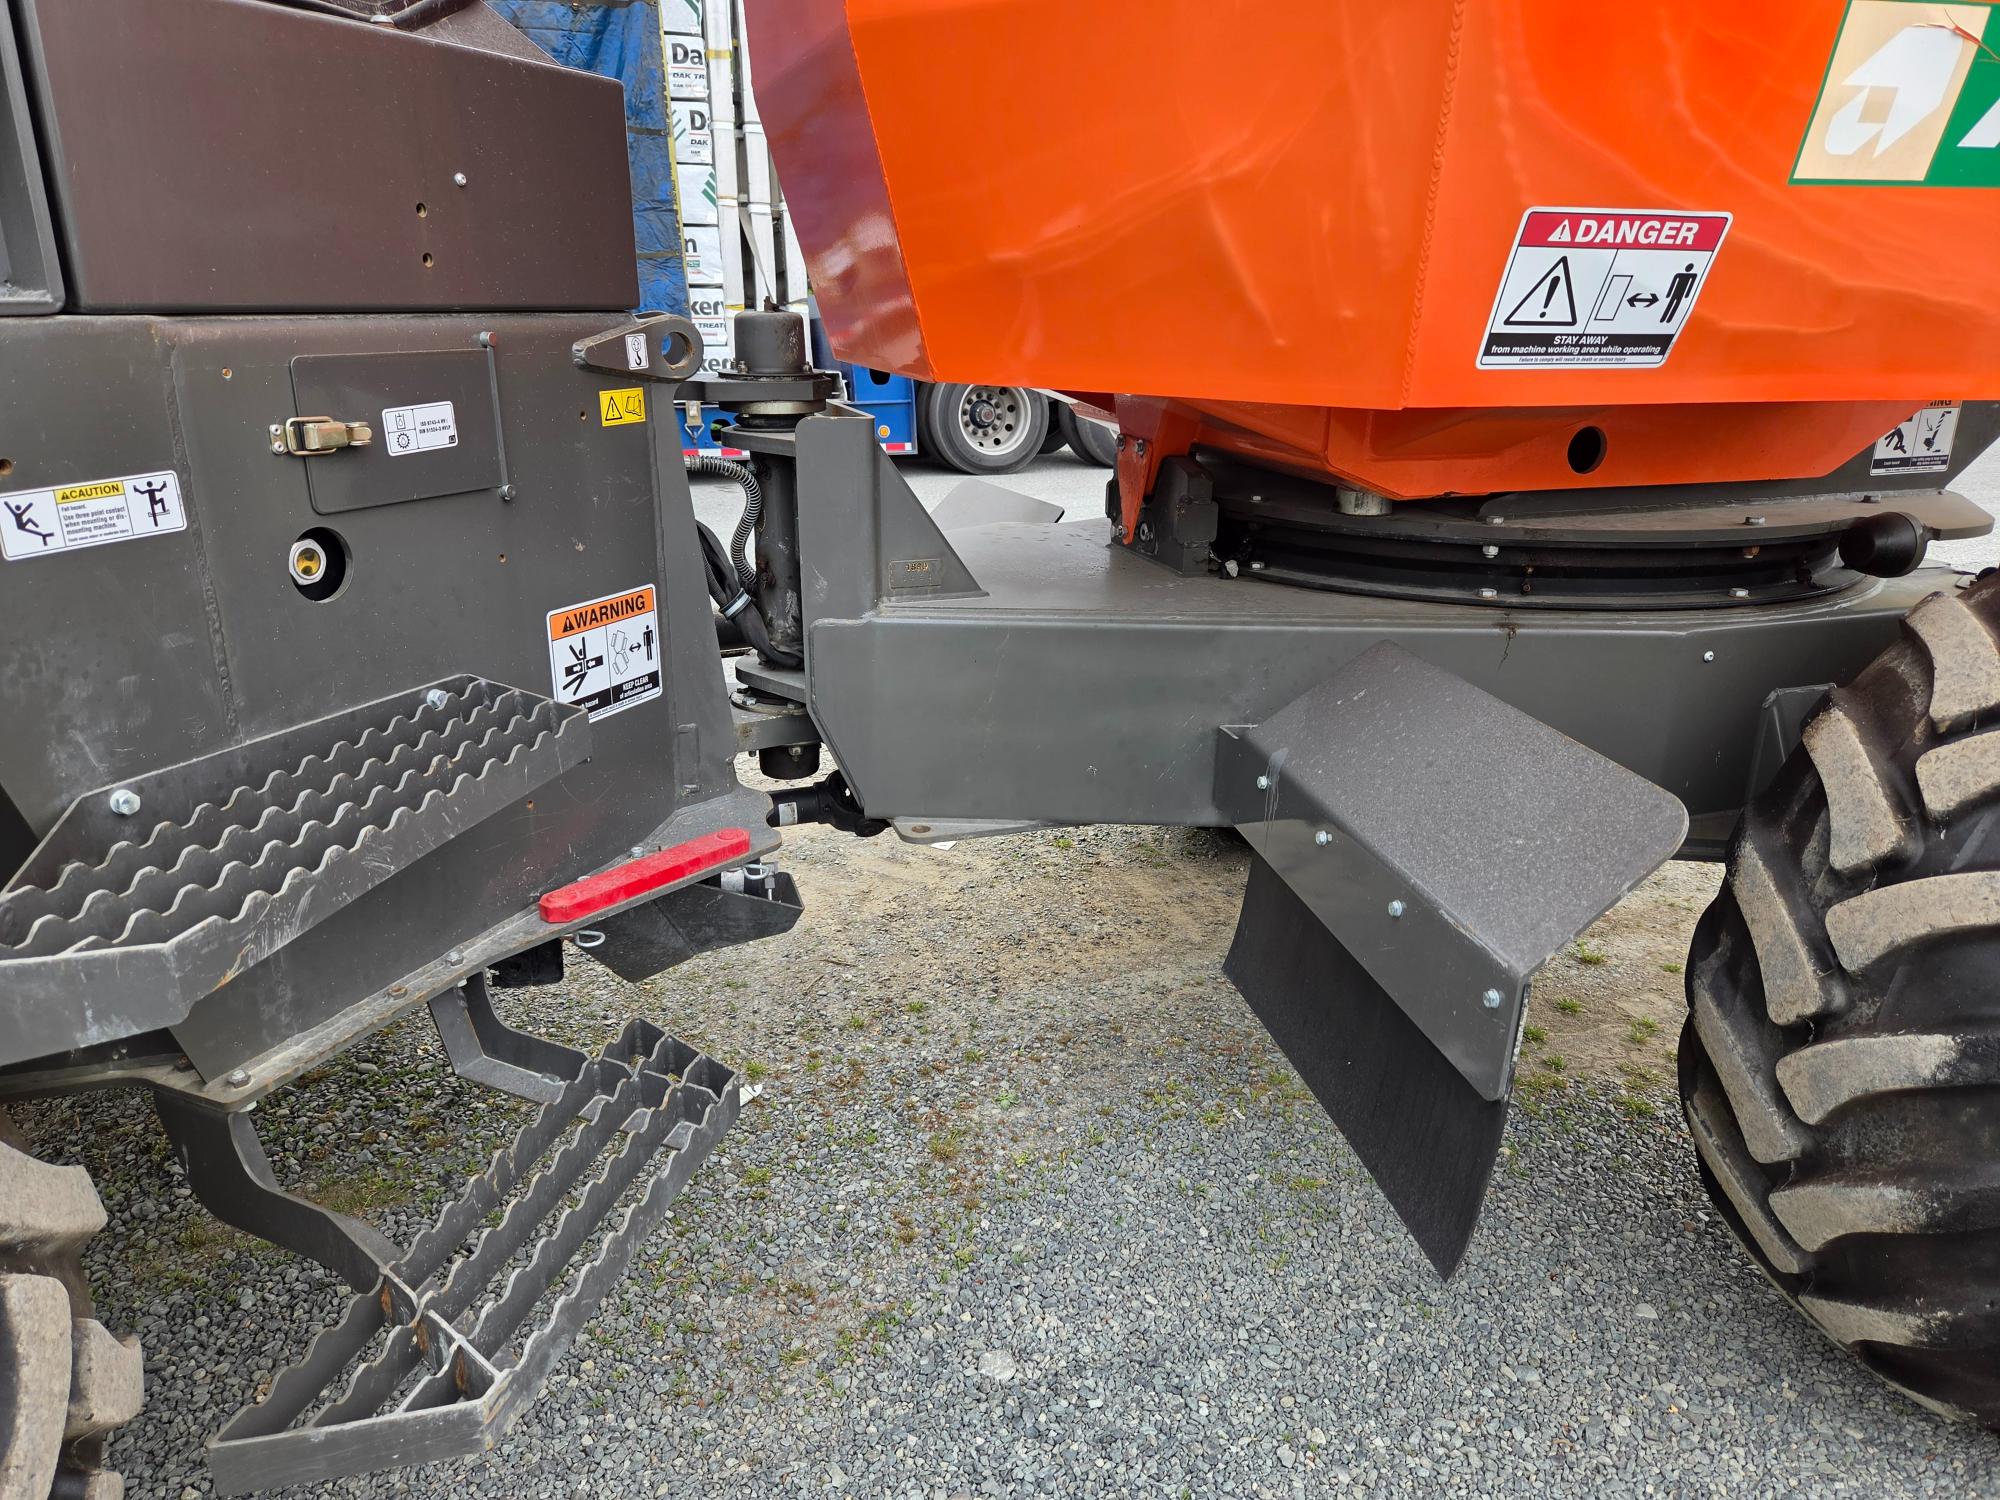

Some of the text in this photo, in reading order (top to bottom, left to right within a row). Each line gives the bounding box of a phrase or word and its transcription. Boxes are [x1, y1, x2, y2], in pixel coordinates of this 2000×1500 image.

[1574, 219, 1700, 246] DANGER
[1553, 335, 1608, 345] STAY AWAY
[1491, 345, 1510, 354] from
[1511, 345, 1546, 354] machine
[1547, 345, 1580, 355] working
[1601, 345, 1622, 354] while
[1623, 345, 1661, 355] operating
[69, 483, 120, 499] CAUTION
[91, 509, 105, 517] point
[106, 506, 126, 514] contact
[81, 516, 108, 525] mounting
[574, 594, 646, 629] WARNING
[622, 675, 649, 691] KEEP CLEAR
